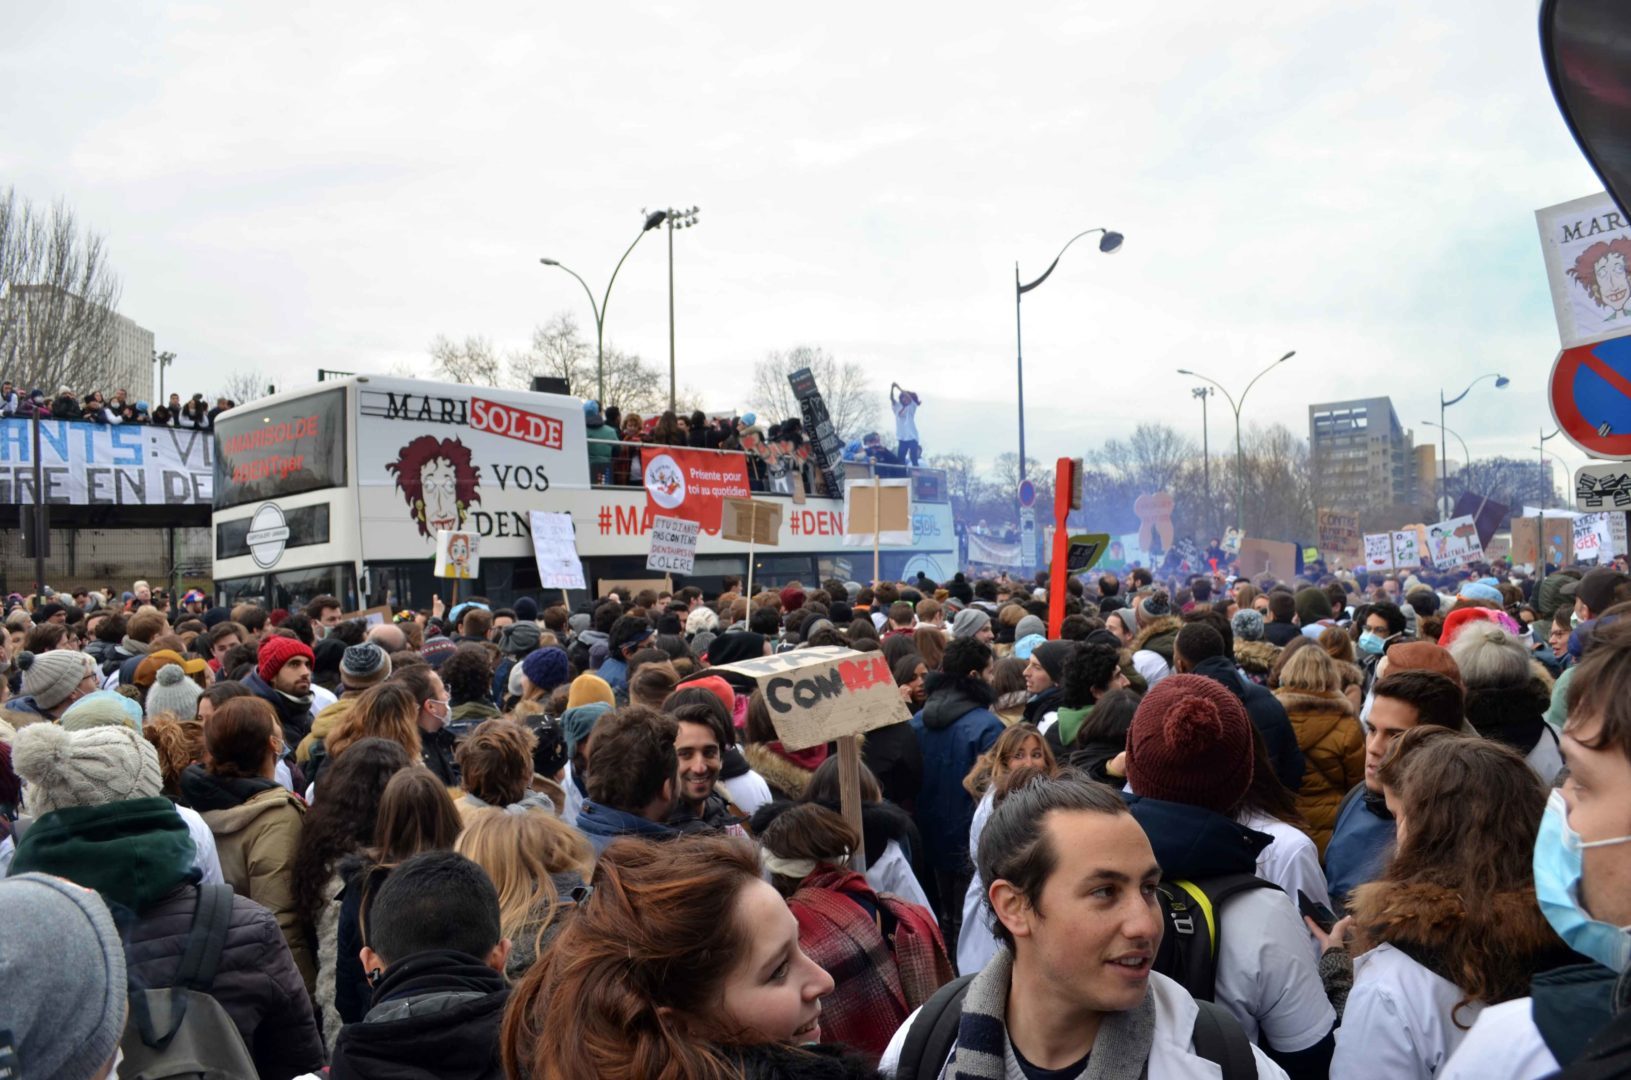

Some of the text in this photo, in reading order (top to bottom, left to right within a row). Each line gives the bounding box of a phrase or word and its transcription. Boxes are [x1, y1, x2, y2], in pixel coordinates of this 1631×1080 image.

[86, 468, 146, 505] EN
[491, 464, 549, 491] VOS
[722, 471, 742, 483] pour
[688, 484, 699, 495] toi
[712, 486, 747, 498] quotidien
